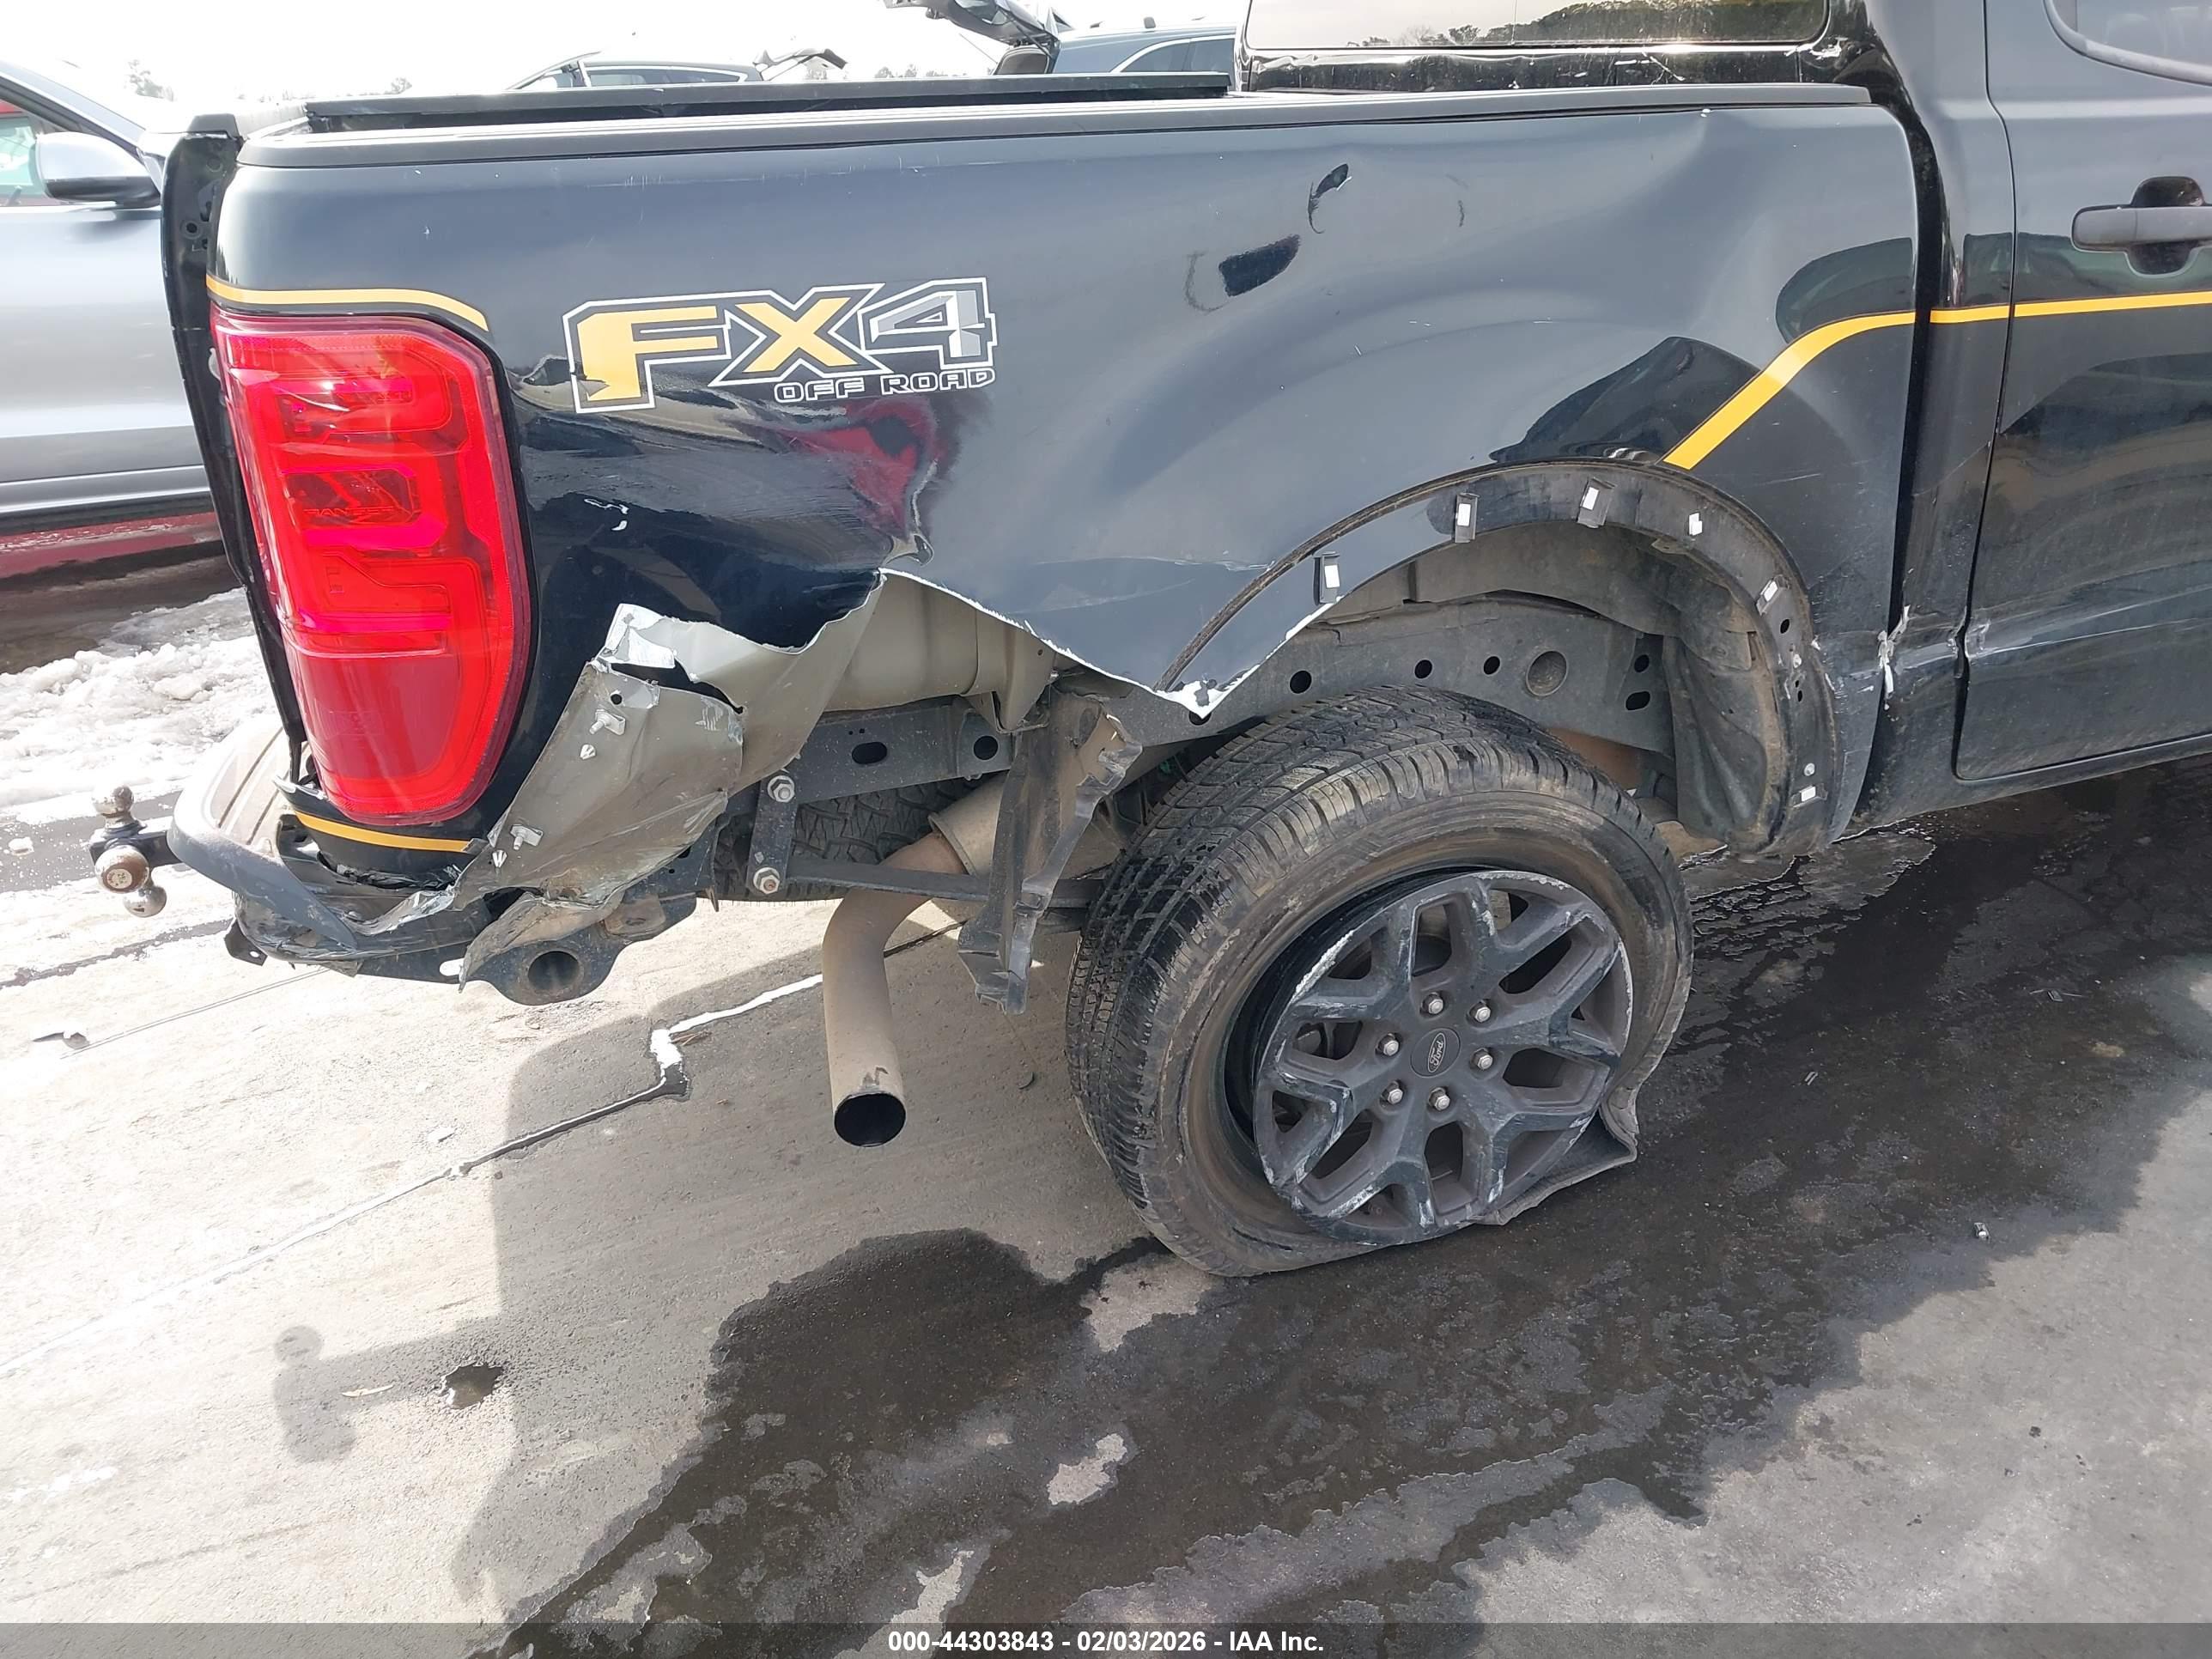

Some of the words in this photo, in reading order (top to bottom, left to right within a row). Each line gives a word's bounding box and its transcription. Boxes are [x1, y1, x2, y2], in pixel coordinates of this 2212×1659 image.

[574, 287, 986, 404] FX4
[774, 377, 866, 403] OFF
[880, 368, 996, 395] ROAD
[1429, 1039, 1444, 1066] Ford
